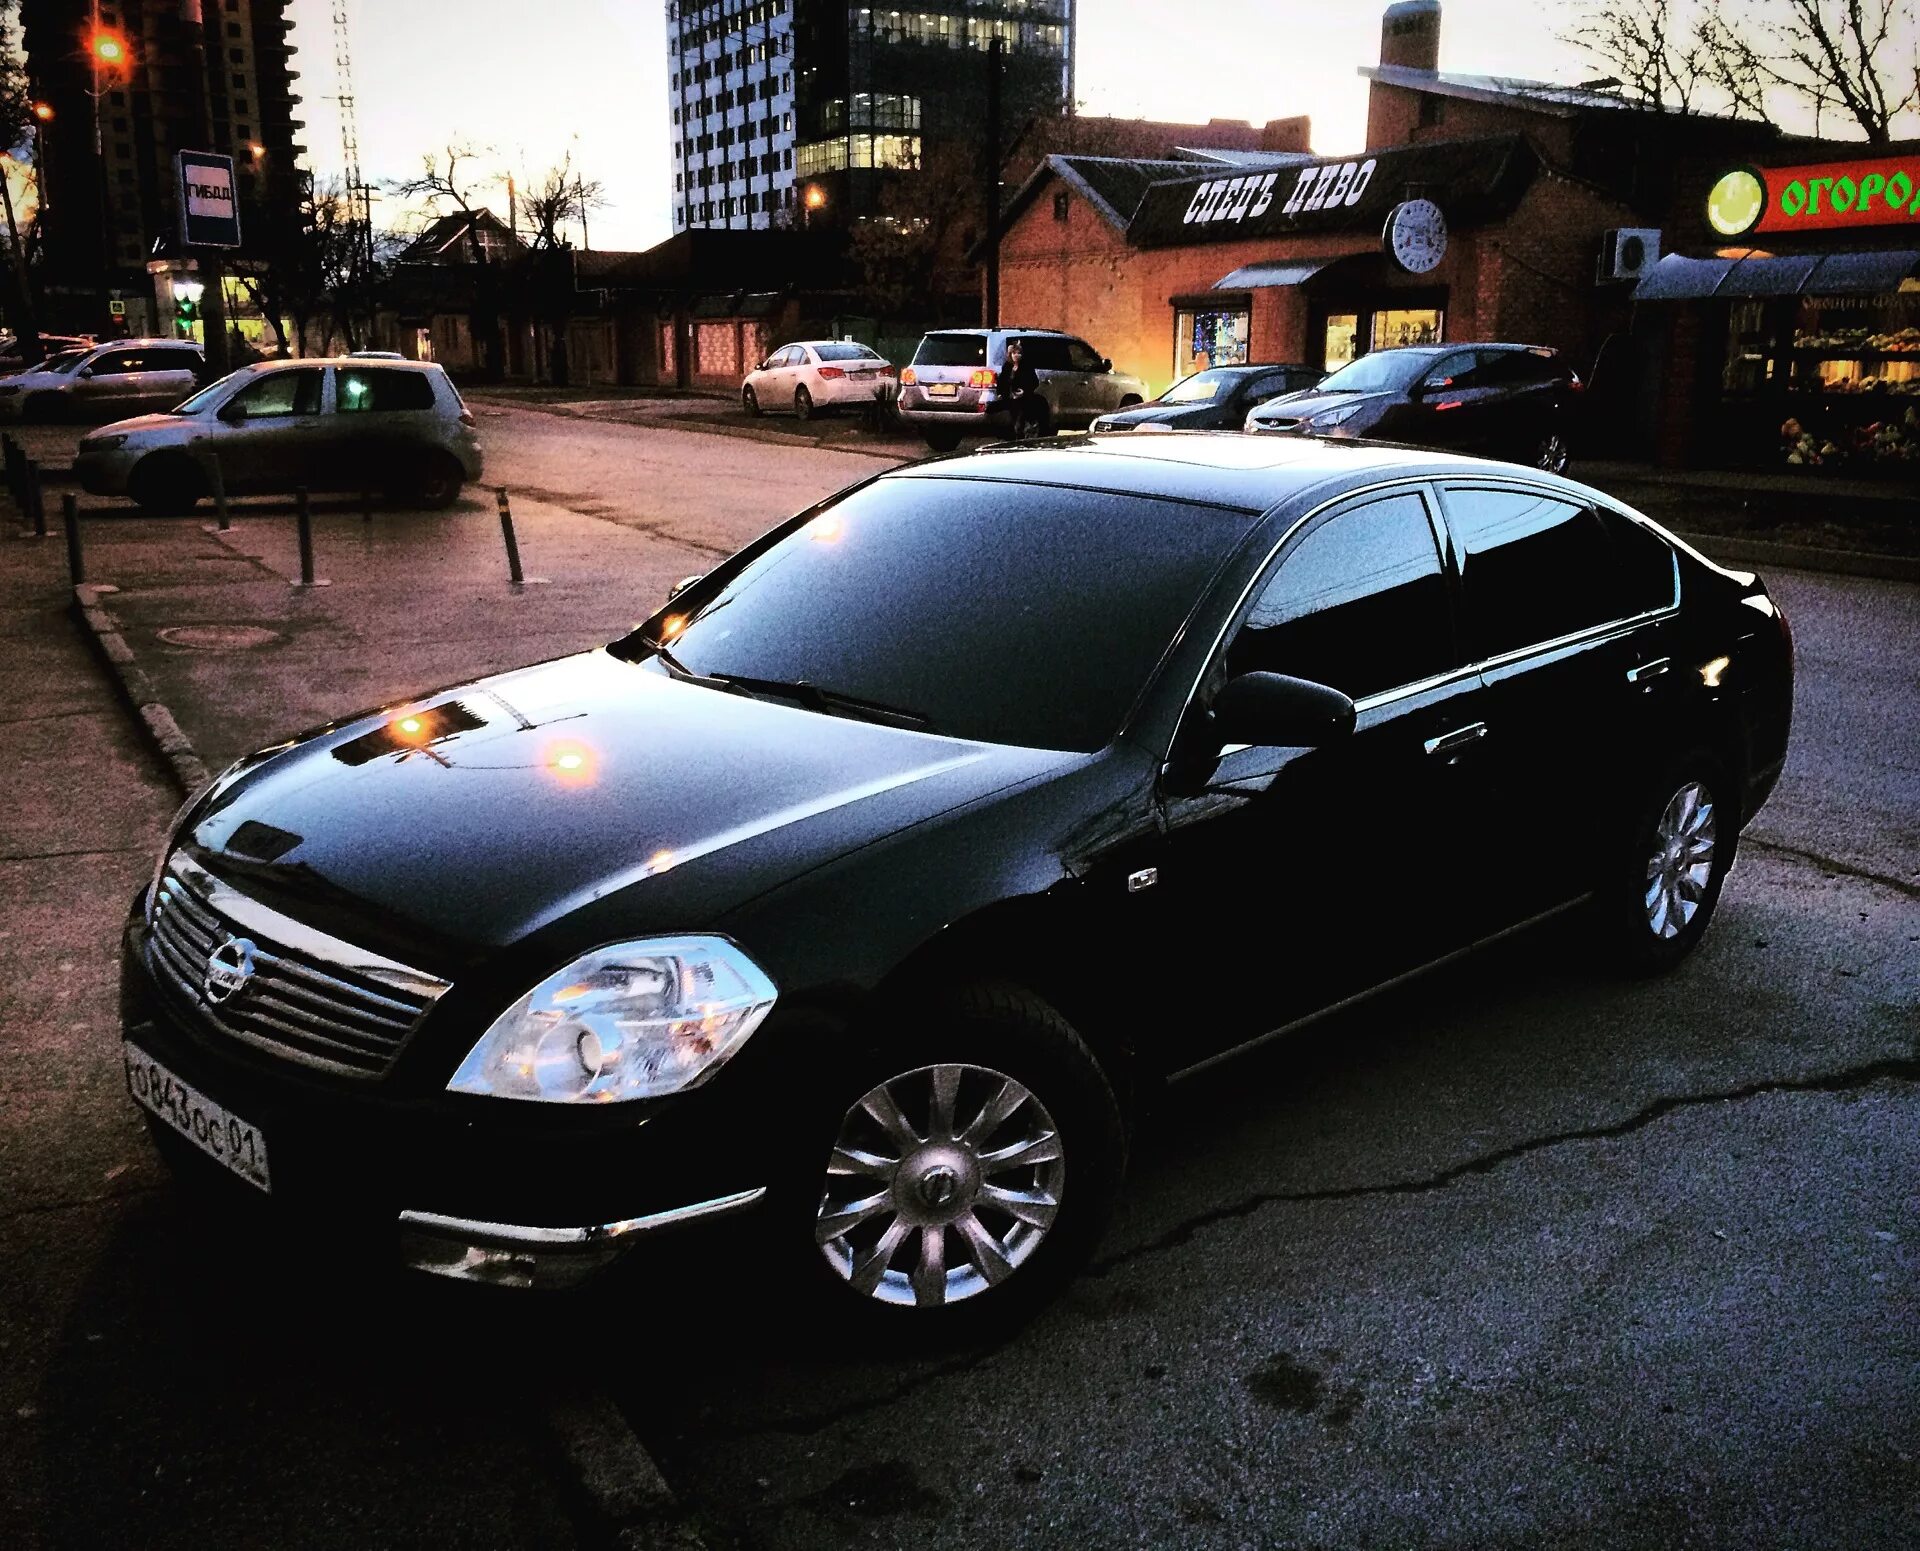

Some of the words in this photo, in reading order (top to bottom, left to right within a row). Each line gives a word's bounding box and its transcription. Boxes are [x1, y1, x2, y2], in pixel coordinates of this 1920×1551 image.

[187, 184, 232, 201] ГИБДД
[1183, 173, 1278, 224] СПЕЦЪ
[1282, 159, 1377, 214] ПИВО
